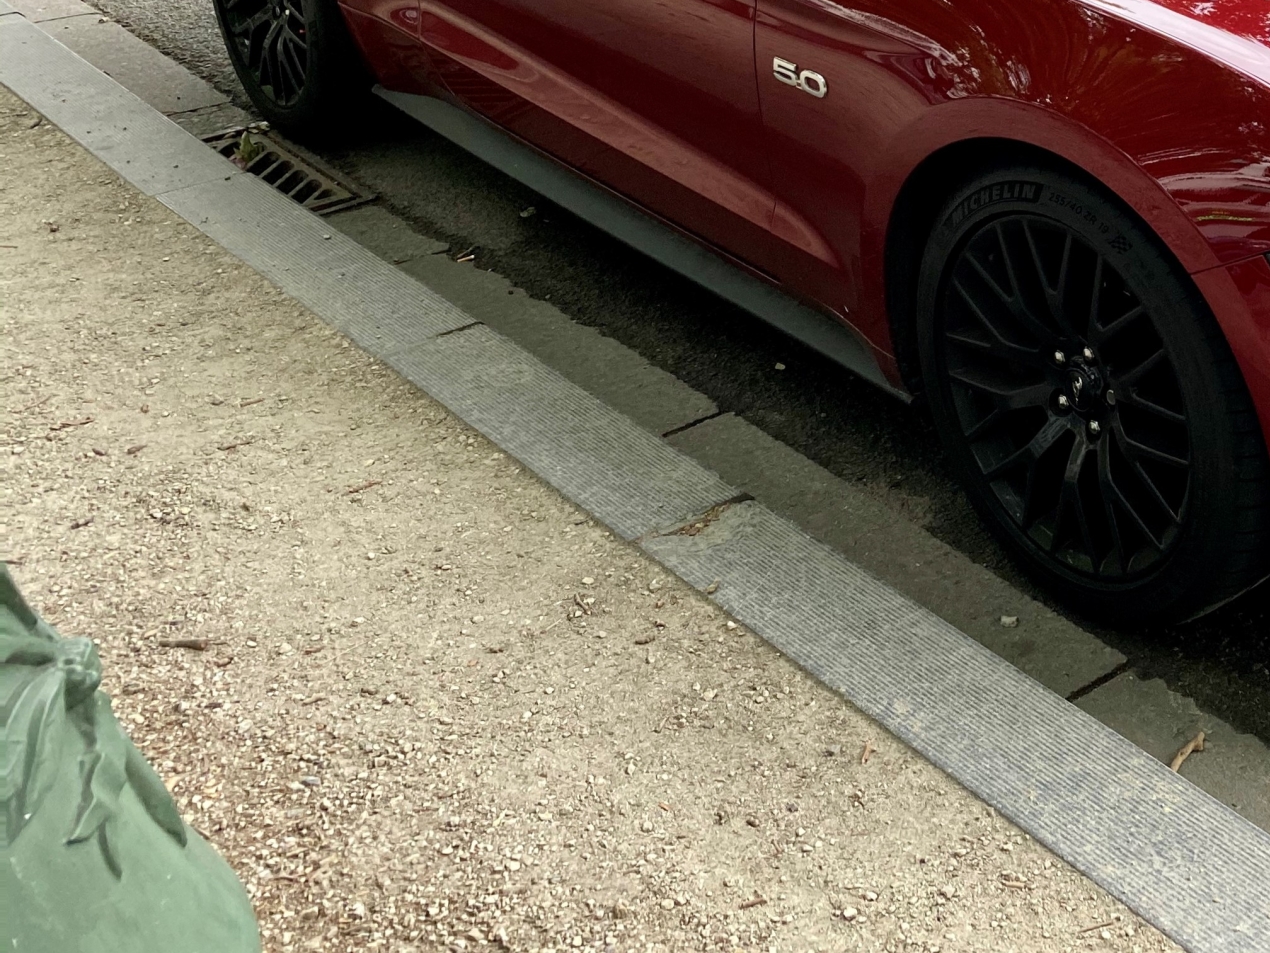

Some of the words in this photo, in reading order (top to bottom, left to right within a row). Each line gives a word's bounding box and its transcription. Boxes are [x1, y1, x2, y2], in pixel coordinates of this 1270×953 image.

[951, 182, 1037, 227] MICHELIN
[1048, 192, 1084, 214] 255/40
[1083, 210, 1098, 226] ZR
[1098, 222, 1110, 235] 19
